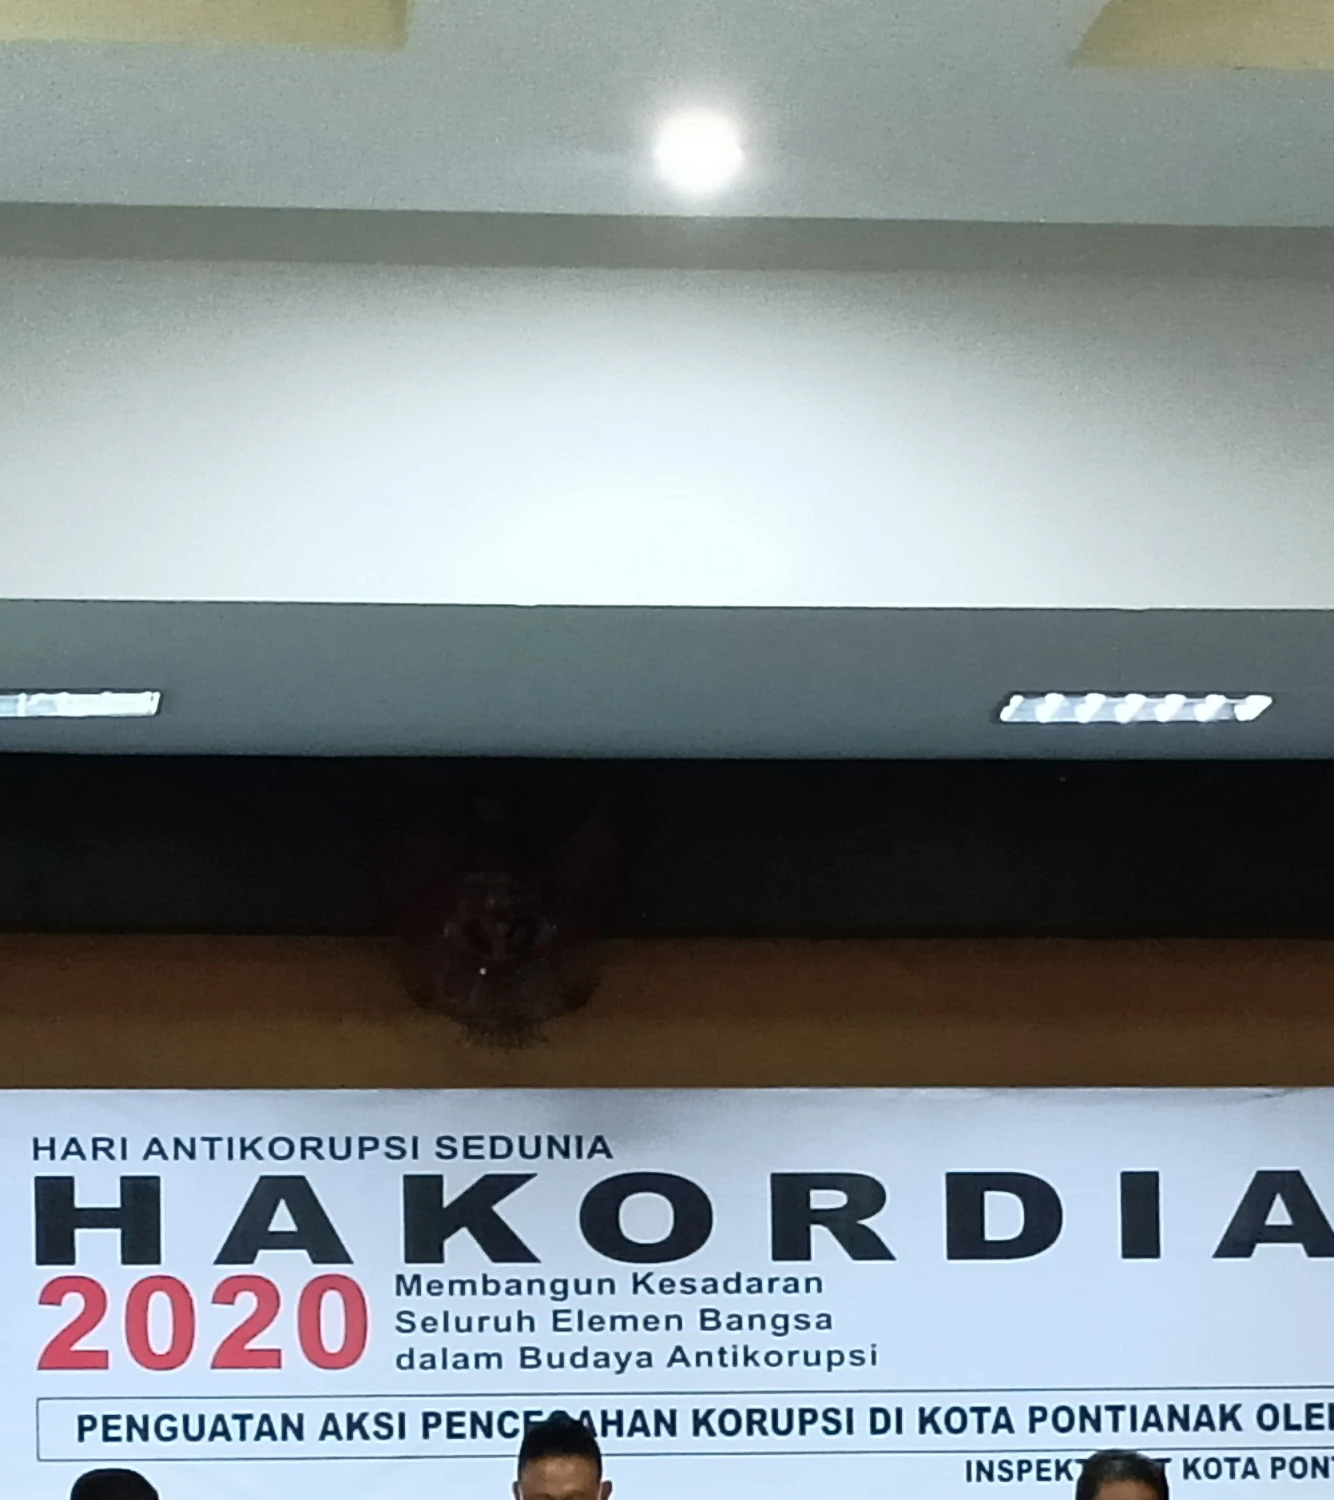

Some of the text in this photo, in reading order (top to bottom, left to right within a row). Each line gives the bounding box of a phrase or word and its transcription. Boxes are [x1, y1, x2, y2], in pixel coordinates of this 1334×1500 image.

[32, 1134, 614, 1162] HARI ANTIKORUPSI SEDUNIA
[395, 1271, 824, 1301] Membangun Kesadaran
[38, 1274, 369, 1371] 2020
[395, 1307, 833, 1337] Seluruh Elemen Bangsa
[396, 1343, 878, 1375] dalam Budaya Antikorupsi
[77, 1412, 305, 1443] PENGUATAN
[318, 1411, 407, 1442] AKSI
[422, 1409, 677, 1441] PENCEAHAN
[692, 1407, 855, 1438] KORUPSI
[869, 1406, 904, 1437] DI
[917, 1405, 1016, 1436] KOTA
[1028, 1403, 1244, 1435] PONTIANAK
[1182, 1456, 1261, 1481] KOTA
